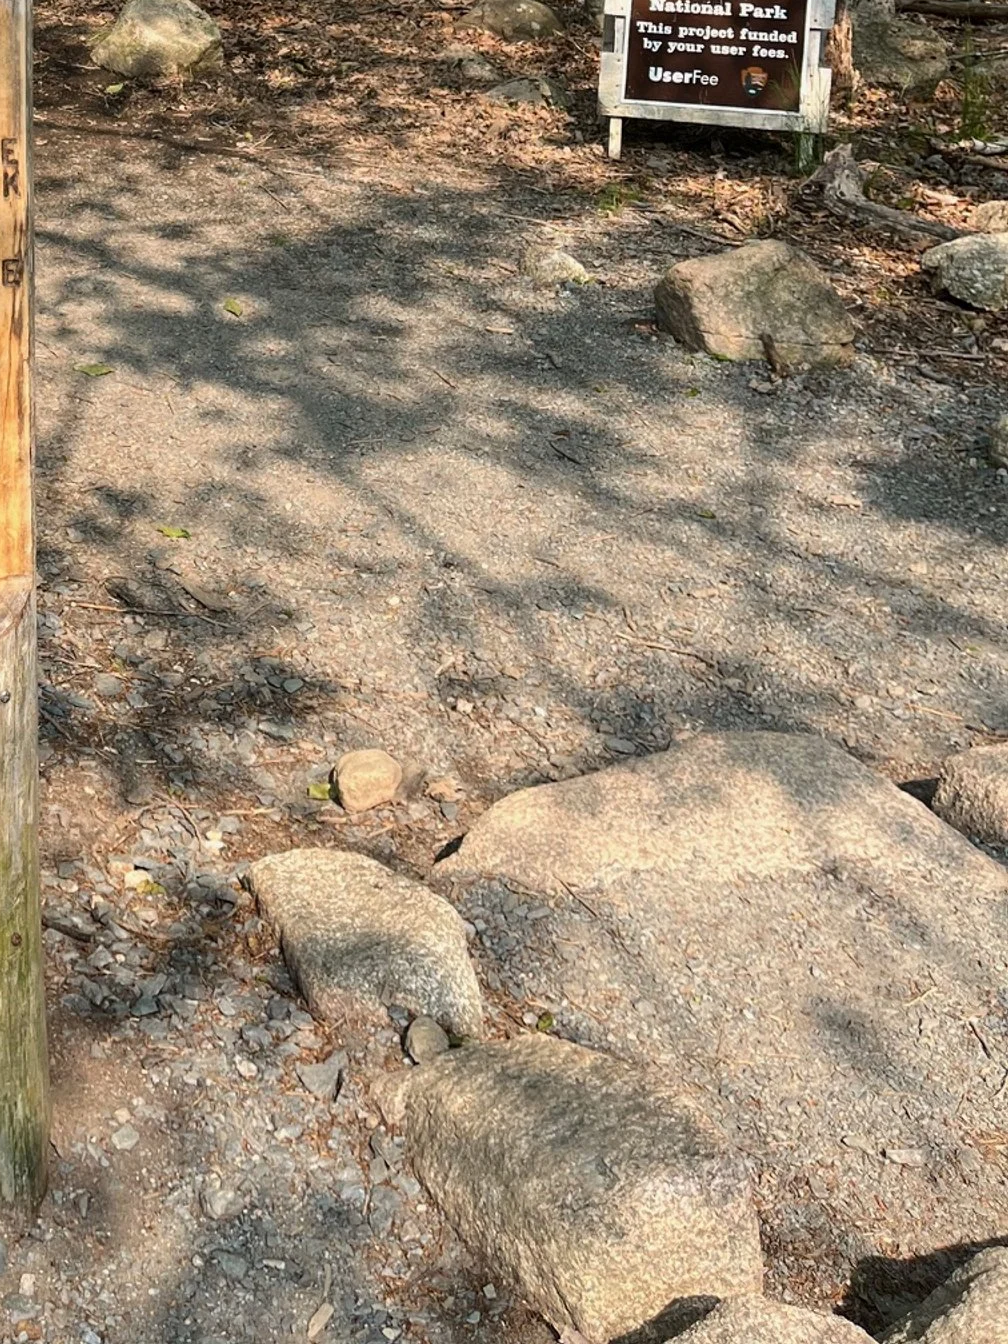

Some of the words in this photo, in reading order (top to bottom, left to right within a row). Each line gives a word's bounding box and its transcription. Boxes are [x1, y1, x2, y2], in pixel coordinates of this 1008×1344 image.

[739, 4, 788, 20] Park
[636, 21, 672, 35] This
[678, 25, 734, 40] project
[739, 28, 798, 43] funded
[642, 37, 662, 52] by
[666, 42, 705, 54] your
[710, 44, 746, 56] user
[751, 45, 790, 59] fees.
